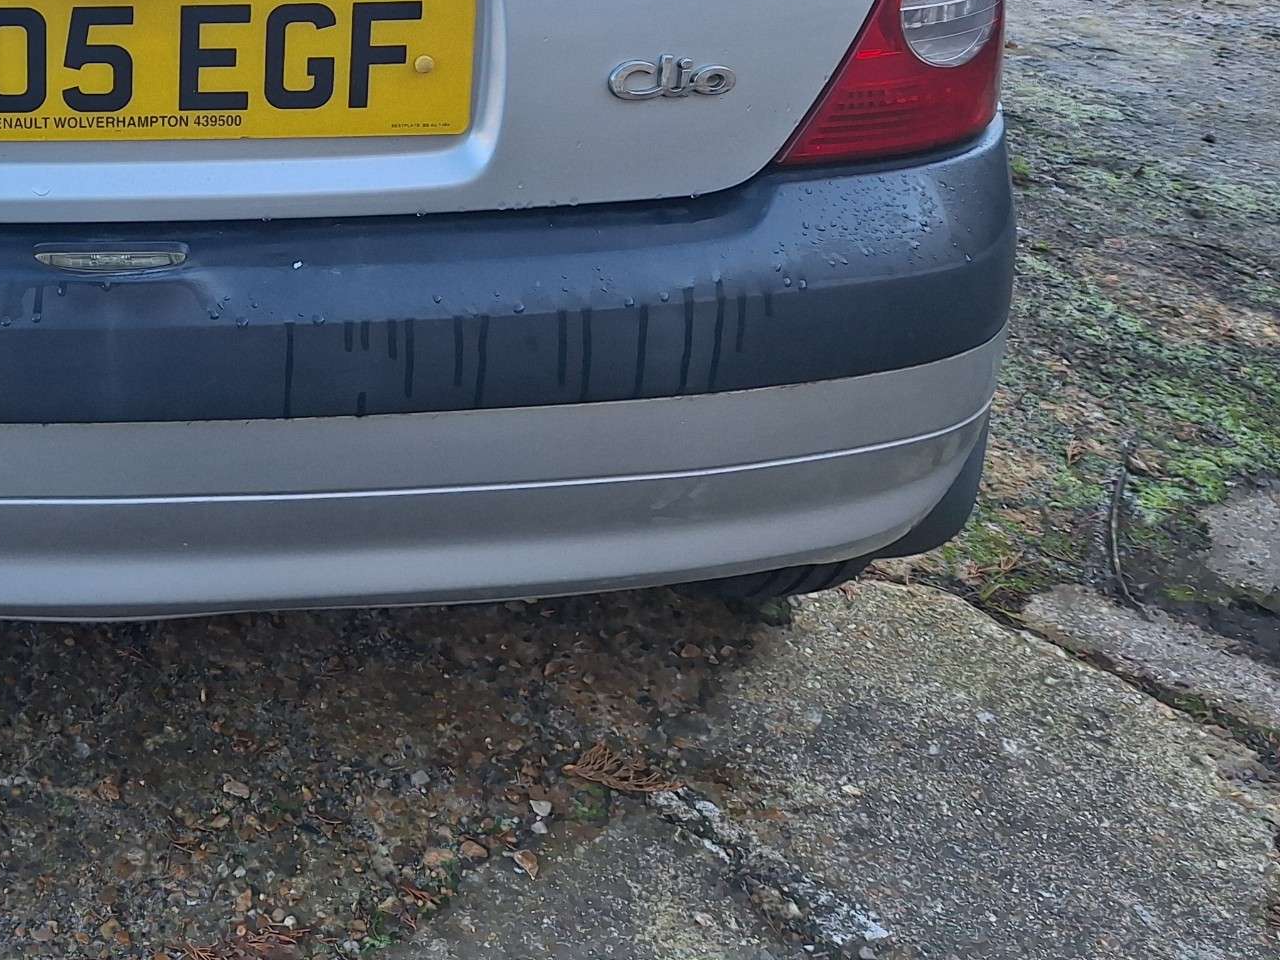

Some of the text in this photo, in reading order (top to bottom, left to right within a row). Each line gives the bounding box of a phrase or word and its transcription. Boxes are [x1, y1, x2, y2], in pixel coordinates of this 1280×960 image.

[179, 1, 424, 110] EGF
[53, 115, 189, 129] WOLVERHAMPTON
[194, 114, 242, 127] 439500
